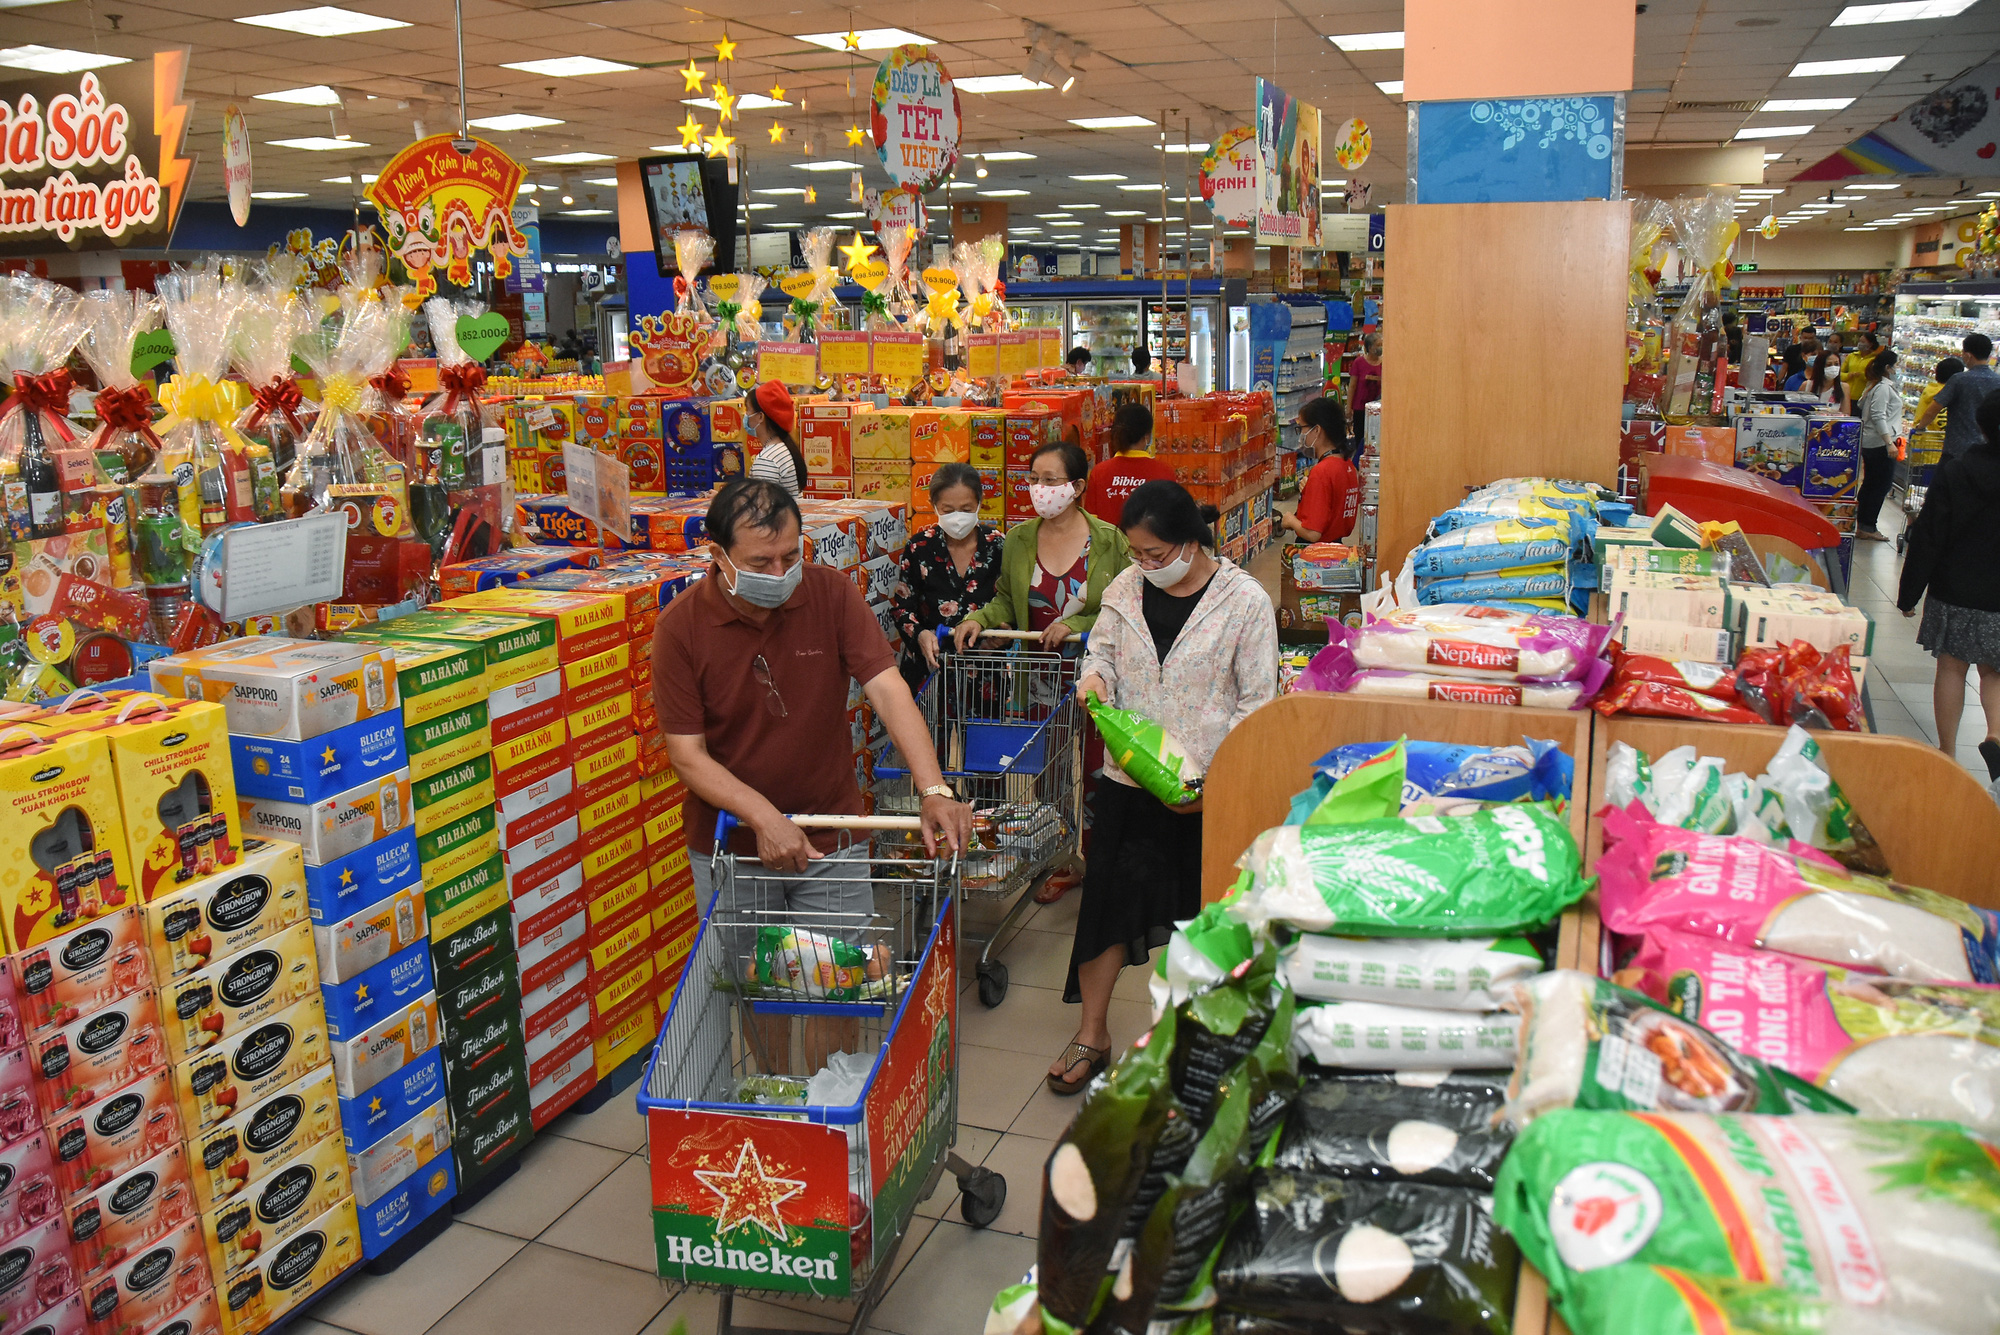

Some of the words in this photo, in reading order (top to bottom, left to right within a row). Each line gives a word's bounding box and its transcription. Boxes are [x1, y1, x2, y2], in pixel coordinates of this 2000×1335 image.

[891, 66, 919, 94] ĐÂY
[921, 72, 942, 98] LÀ
[50, 79, 124, 161] Sốc
[898, 96, 942, 141] TẾT
[900, 141, 938, 172] VIỆT
[392, 166, 429, 203] Mừng
[425, 151, 458, 178] Xuân
[1205, 177, 1247, 194] MẠNH
[0, 194, 36, 226] m
[44, 177, 97, 234] tận
[104, 161, 156, 230] gốc
[891, 203, 908, 216] TẾT
[1372, 233, 1385, 249] 0
[924, 276, 957, 287] 763.900đ
[1045, 264, 1058, 275] 05
[711, 282, 739, 291] 769.500đ
[782, 279, 815, 293] 769.500đ
[663, 402, 682, 410] OREO
[716, 407, 723, 415] LU
[804, 407, 811, 415] LU
[586, 415, 604, 424] COSY
[630, 424, 645, 432] COSY
[805, 423, 814, 433] LU
[859, 422, 879, 436] AFC
[914, 421, 939, 439] AFC
[67, 459, 90, 469] Select
[915, 474, 932, 488] AF
[1112, 475, 1146, 487] Bibica
[539, 511, 585, 539] Tiger
[874, 516, 897, 541] Tiger
[821, 531, 846, 558] Tiger
[69, 586, 96, 602] KitKat
[574, 612, 588, 628] BIA
[588, 608, 600, 624] HÀ
[600, 604, 614, 620] NỘI
[498, 639, 514, 654] BIA
[513, 631, 527, 648] HÀ
[526, 629, 541, 646] NỘI
[1432, 641, 1513, 667] Neptune
[420, 671, 437, 685] BIA
[437, 661, 452, 680] HÀ
[451, 657, 469, 676] NỘI
[234, 685, 278, 702] SAPPORO
[320, 677, 359, 699] SAPPORO
[1434, 684, 1517, 706] Neptune
[236, 698, 263, 707] PREMIUM
[162, 734, 187, 746] STRONGBOW
[359, 725, 395, 748] BLUECAP
[143, 758, 164, 768] CHILL
[165, 742, 210, 761] STRONGBOW
[250, 745, 274, 755] SAPPORO
[280, 755, 290, 764] 24
[33, 767, 62, 781] STRONGBOW
[150, 763, 173, 777] XUÂN
[191, 752, 207, 765] SẮC
[12, 793, 36, 806] CHILL
[37, 775, 90, 799] STRONGBOW
[21, 802, 46, 815] XUÂN
[70, 786, 87, 800] SẮC
[256, 811, 301, 830] SAPPORO
[338, 800, 375, 825] SAPPORO
[375, 842, 410, 866] BLUECAP
[216, 889, 263, 916] STRONGBOW
[224, 911, 240, 921] APPLE
[240, 902, 258, 915] CIDERS
[226, 932, 243, 946] Gold
[243, 922, 265, 937] Apple
[355, 916, 391, 942] SAPPORO
[449, 938, 472, 958] Trúc
[472, 920, 498, 944] Bạch
[68, 938, 105, 960] STRONGBOW
[76, 975, 88, 985] Red
[87, 967, 107, 979] Berries
[390, 953, 423, 978] BLUECAP
[228, 965, 273, 992] STRONGBOW
[456, 989, 480, 1009] Trúc
[479, 969, 505, 994] Bạch
[237, 1008, 255, 1021] Gold
[255, 997, 275, 1012] Apple
[84, 1020, 122, 1044] STRONGBOW
[370, 1028, 404, 1056] SAPPORO
[461, 1037, 483, 1059] Trúc
[482, 1018, 509, 1043] Bạch
[92, 1057, 103, 1067] Red
[103, 1048, 123, 1061] Berries
[241, 1038, 286, 1066] STRONGBOW
[251, 1079, 268, 1094] Gold
[268, 1069, 288, 1085] Apple
[403, 1062, 435, 1089] BLUECAP
[910, 1058, 926, 1100] SẮC
[101, 1101, 137, 1126] STRONGBOW
[253, 1106, 297, 1139] STRONGBOW
[110, 1136, 121, 1148] Red
[120, 1127, 140, 1141] Berries
[883, 1126, 902, 1172] TÂN
[904, 1086, 927, 1142] XUÂN
[899, 1115, 927, 1188] 2021
[265, 1177, 308, 1210] STRONGBOW
[375, 1191, 408, 1222] BLUECAP
[133, 1256, 168, 1282] STRONGBOW
[276, 1243, 319, 1277] STRONGBOW
[666, 1235, 838, 1281] Heineken
[291, 1279, 313, 1296] Honey
